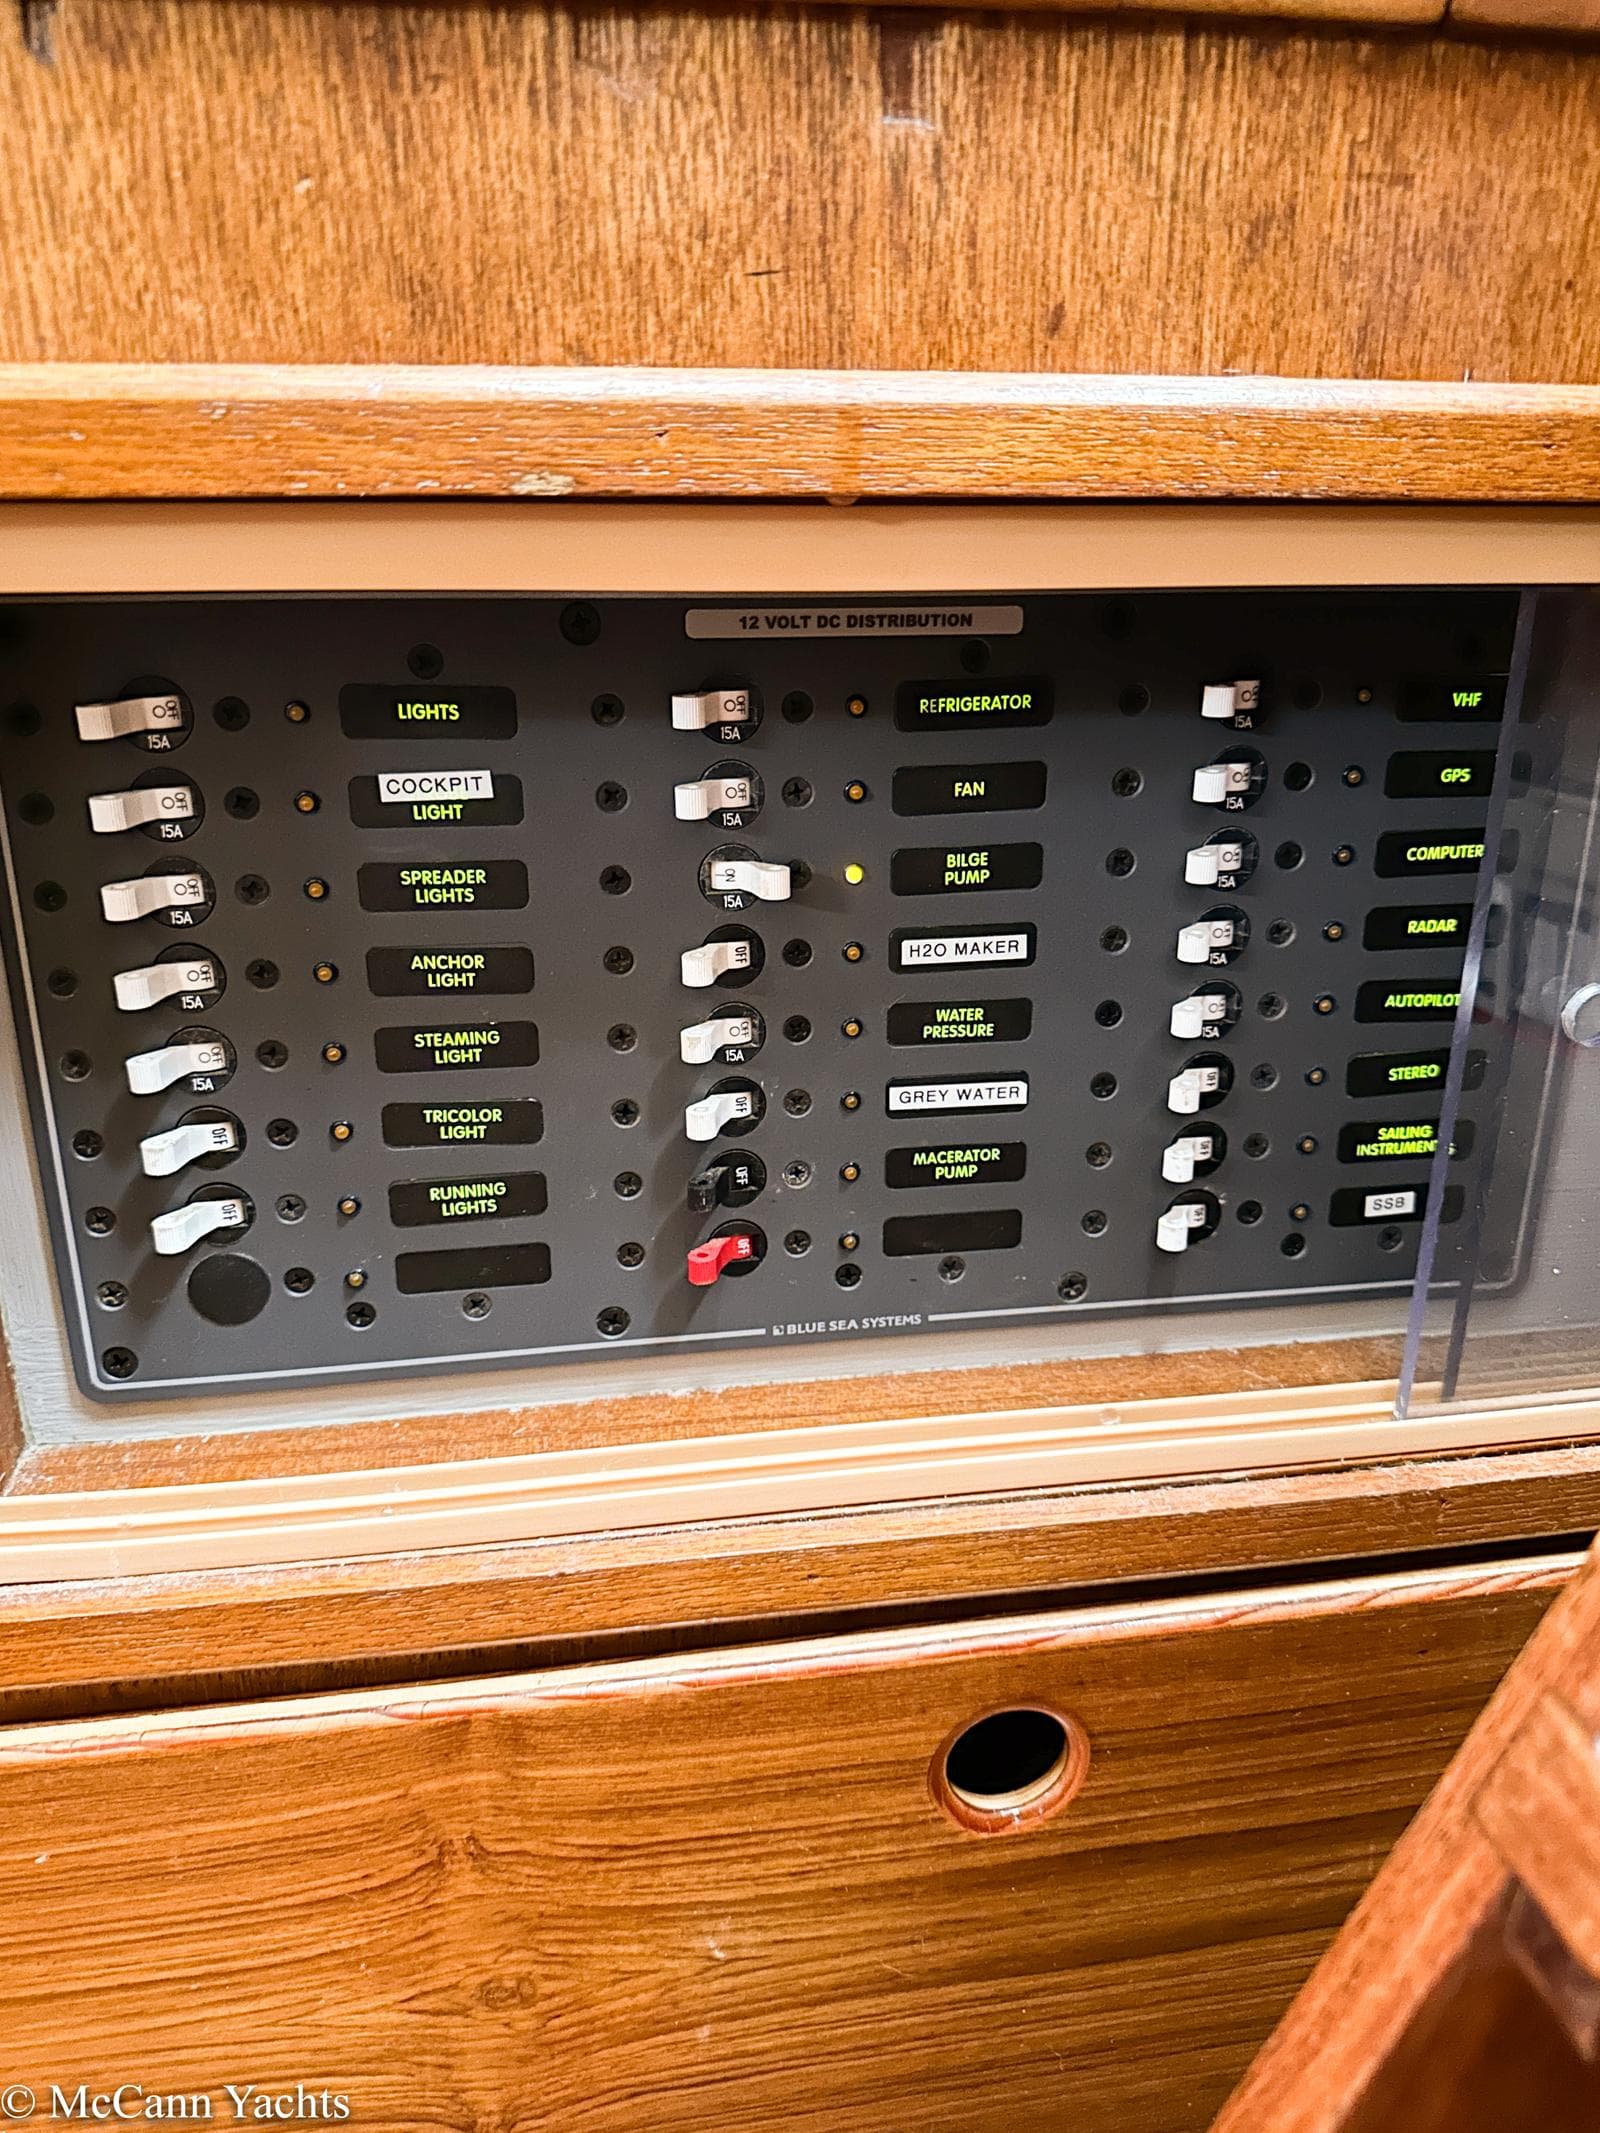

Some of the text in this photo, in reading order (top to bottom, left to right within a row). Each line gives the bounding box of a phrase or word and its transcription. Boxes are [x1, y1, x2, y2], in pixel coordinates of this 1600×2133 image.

[739, 613, 974, 630] 12 VOLT DC DISTRIBUTION
[736, 695, 746, 715] OFF
[919, 694, 1033, 714] REFRIGERATOR
[1452, 692, 1482, 707] VHF
[166, 700, 179, 720] OFF
[397, 703, 460, 721] LIGHTS
[1234, 715, 1252, 728] 15A
[720, 726, 741, 740] 15A
[147, 735, 171, 749] 15A
[1440, 768, 1471, 783] GPS
[386, 776, 483, 795] COCKPIT
[737, 782, 747, 801] OFF
[954, 781, 985, 797] FAN
[174, 792, 188, 812] OFF
[1226, 797, 1244, 809] 15A
[412, 804, 464, 821] LIGHT
[722, 812, 742, 826] 15A
[160, 824, 184, 838] 15A
[946, 852, 989, 868] BILGE
[1406, 843, 1485, 861] COMPUTER
[400, 869, 487, 885] SPREADER
[724, 868, 736, 883] ON
[944, 869, 990, 886] PUMP
[1217, 875, 1236, 888] 15A
[186, 879, 200, 897] OFF
[415, 888, 475, 904] LIGHTS
[723, 895, 743, 908] 15A
[170, 911, 193, 925] 15A
[1407, 918, 1458, 934] RADAR
[735, 946, 747, 964] OFF
[909, 940, 1020, 958] H2O MAKER
[411, 954, 485, 970] ANCHOR
[1209, 953, 1227, 965] 15A
[200, 964, 213, 983] OFF
[427, 972, 476, 988] LIGHT
[181, 995, 204, 1010] 15A
[1384, 993, 1462, 1008] AUTOPILOT
[936, 1008, 984, 1022] WATER
[414, 1030, 500, 1048] STEAMING
[923, 1023, 994, 1039] PRESSURE
[210, 1046, 224, 1064] OFF
[435, 1048, 483, 1064] LIGHT
[725, 1050, 745, 1062] 15A
[1388, 1064, 1441, 1082] STEREO
[192, 1078, 214, 1091] 15A
[899, 1086, 1020, 1104] GREY WATER
[735, 1096, 748, 1113] OFF
[422, 1108, 503, 1123] TRICOLOR
[211, 1128, 228, 1145] OFF
[439, 1125, 487, 1140] LIGHT
[1377, 1125, 1433, 1141] SAILING
[913, 1148, 1000, 1166] MACERATOR
[735, 1166, 749, 1186] OFF
[935, 1165, 978, 1180] PUMP
[429, 1182, 507, 1201] RUNNING
[222, 1203, 238, 1221] OFF
[441, 1199, 498, 1217] LIGHTS
[1372, 1197, 1405, 1211] SSB
[737, 1238, 750, 1255] OFF
[786, 1314, 922, 1335] BLUE SEA SYSTEMS
